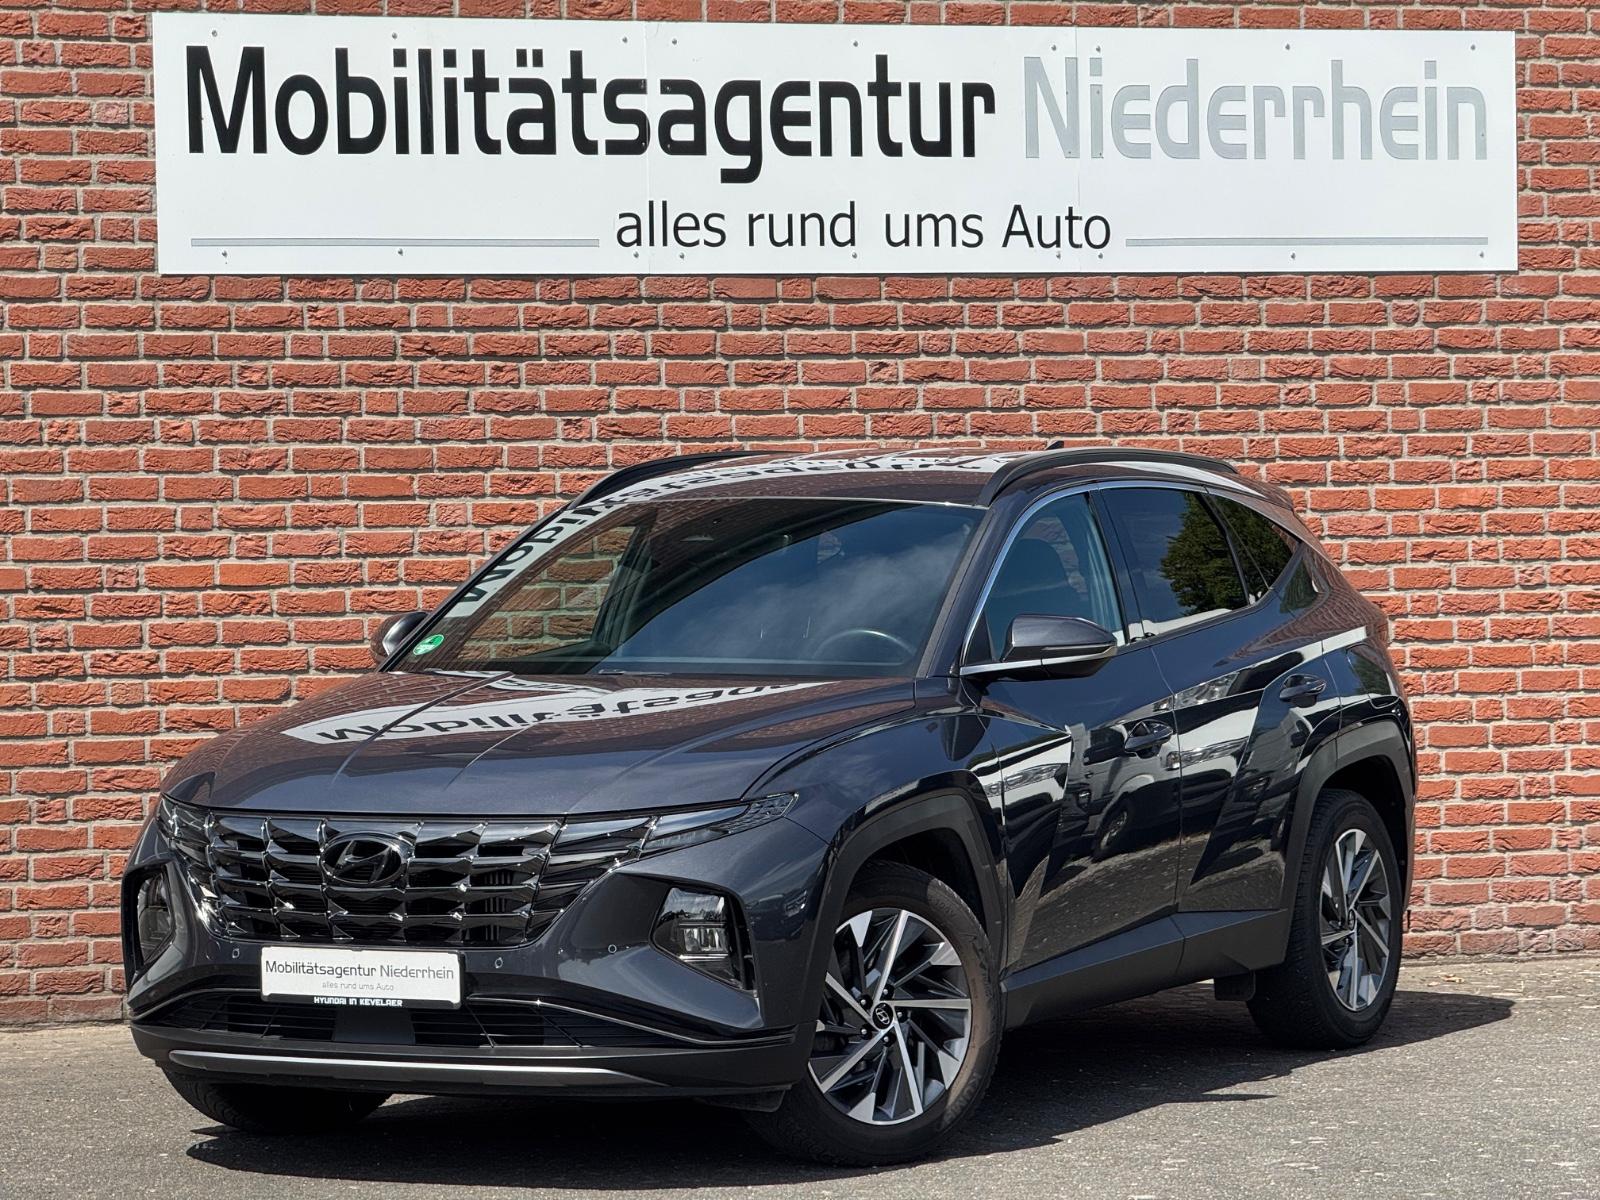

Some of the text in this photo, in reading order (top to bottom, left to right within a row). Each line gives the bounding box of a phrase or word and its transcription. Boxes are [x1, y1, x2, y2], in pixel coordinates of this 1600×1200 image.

[185, 44, 1488, 184] Mobilitätsagentur Niederrhein
[615, 200, 1111, 250] alles rund ums Auto
[265, 960, 454, 980] Mobilitätsagentur Niederrhein
[322, 981, 338, 989] alles
[340, 982, 357, 990] rund
[376, 983, 395, 992] Auto
[313, 996, 347, 1005] HYUNDAI
[360, 998, 403, 1007] KEVELAER
